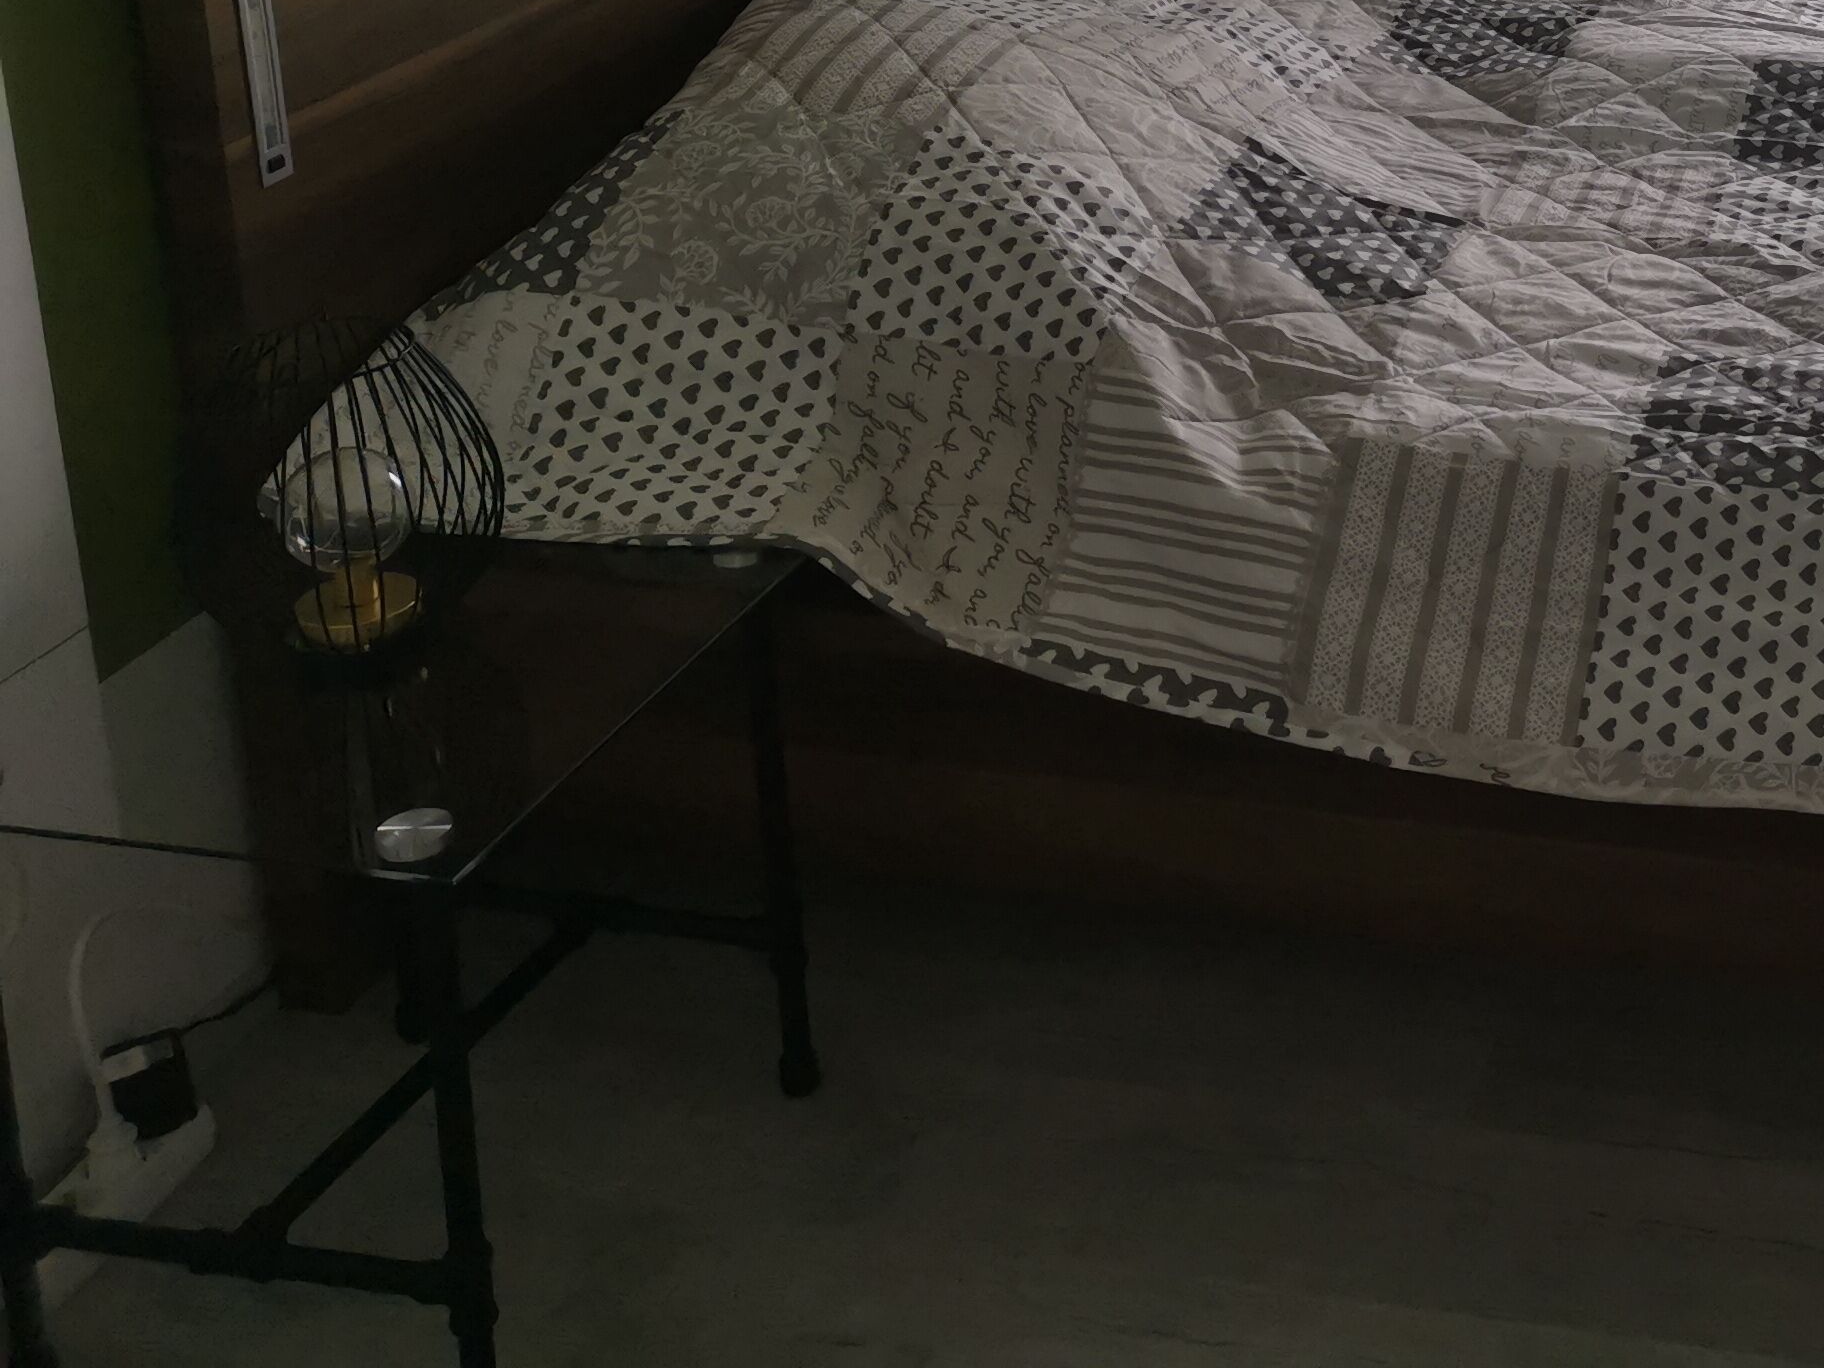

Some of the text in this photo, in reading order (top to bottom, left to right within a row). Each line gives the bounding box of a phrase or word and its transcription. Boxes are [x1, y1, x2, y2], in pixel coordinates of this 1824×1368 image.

[866, 371, 880, 399] on
[886, 392, 928, 423] if
[947, 369, 971, 422] and
[989, 361, 1017, 428] with
[1025, 393, 1047, 455] love
[964, 425, 996, 480] you,
[910, 460, 949, 540] doubt
[1004, 457, 1038, 522] with
[951, 494, 979, 543] and
[1040, 523, 1060, 547] on
[977, 518, 1011, 577] you,
